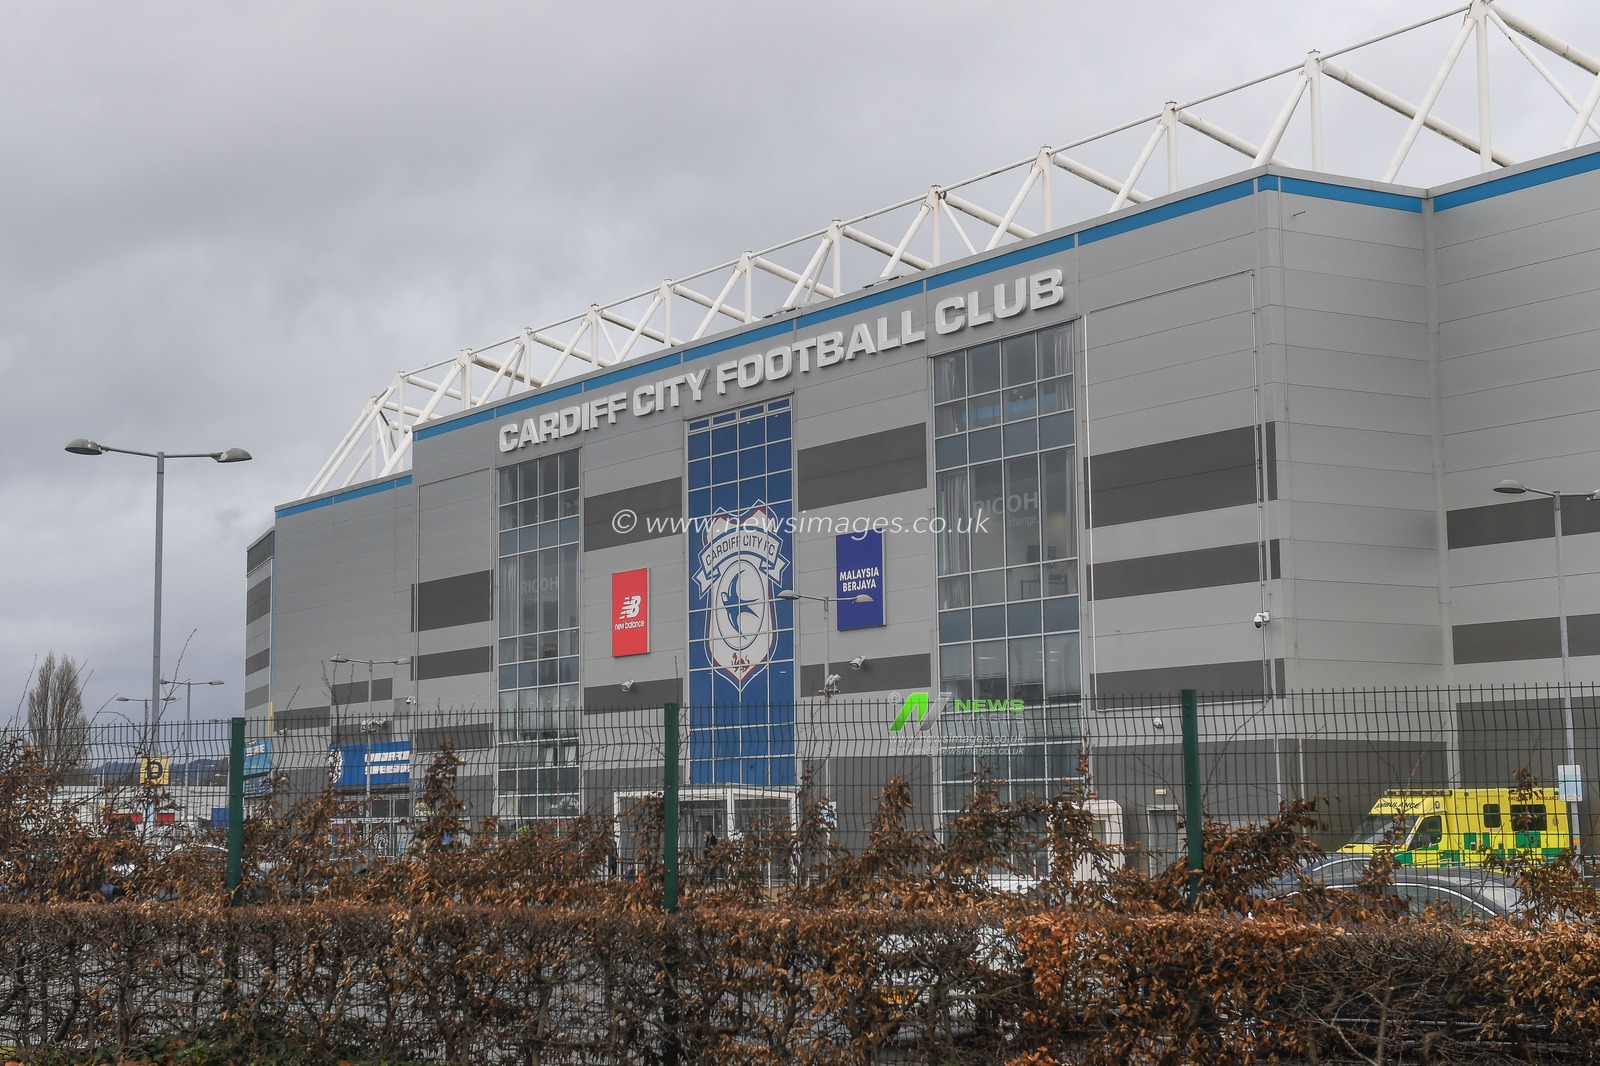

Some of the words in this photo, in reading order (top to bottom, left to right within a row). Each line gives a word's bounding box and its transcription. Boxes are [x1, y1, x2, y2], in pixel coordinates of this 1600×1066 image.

[499, 391, 628, 453] CARDIFF
[632, 367, 709, 417] CITY
[716, 310, 926, 395] FOOTBALL
[934, 269, 1064, 335] CLUB
[705, 536, 739, 566] CARDIFF
[742, 535, 763, 549] CITY
[839, 566, 880, 581] MALAYSIA
[842, 578, 877, 593] BERJAYA
[615, 622, 625, 631] new
[625, 620, 645, 629] balance
